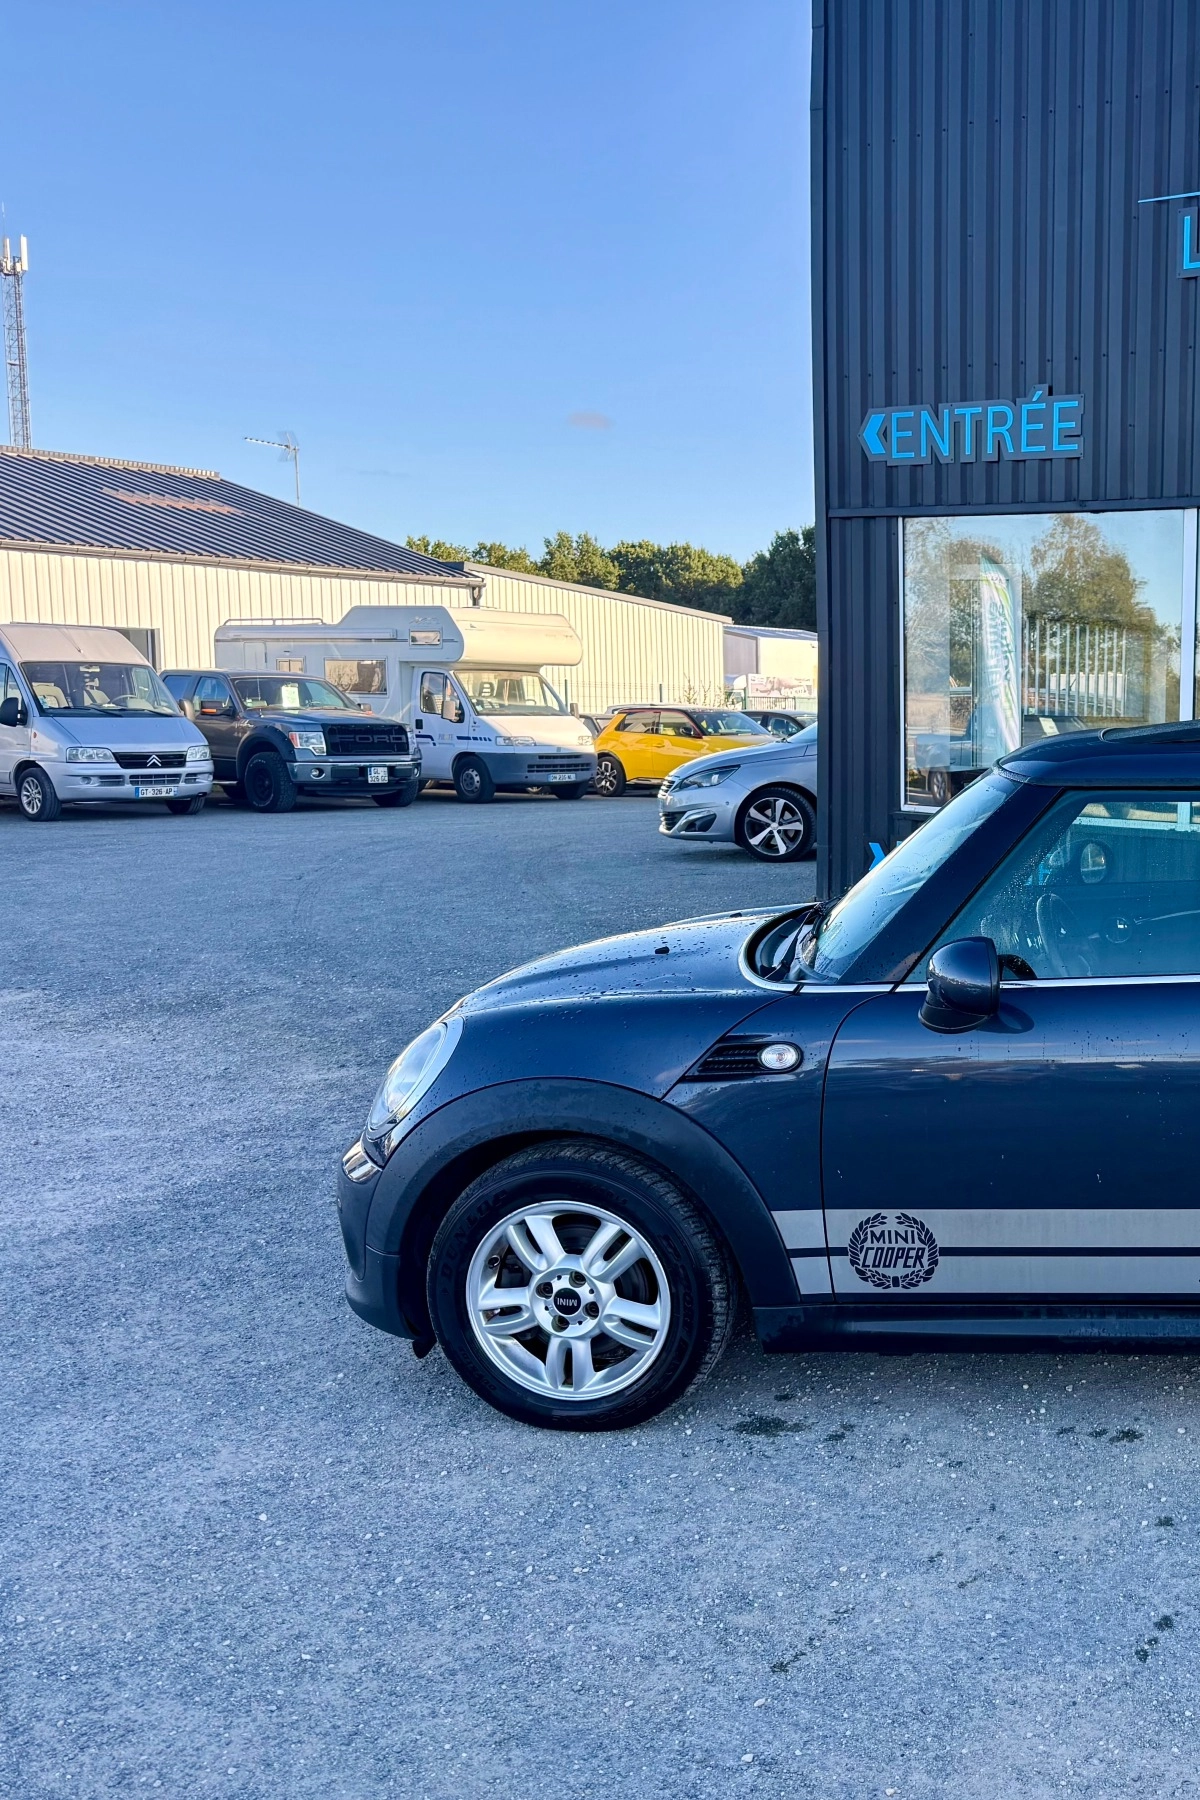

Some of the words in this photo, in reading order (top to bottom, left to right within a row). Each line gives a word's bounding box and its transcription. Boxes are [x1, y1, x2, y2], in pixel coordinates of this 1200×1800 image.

[891, 390, 1079, 459] ENTRÉE
[870, 1229, 916, 1245] MINI
[861, 1246, 926, 1269] COOPER
[556, 1297, 578, 1307] MINI
